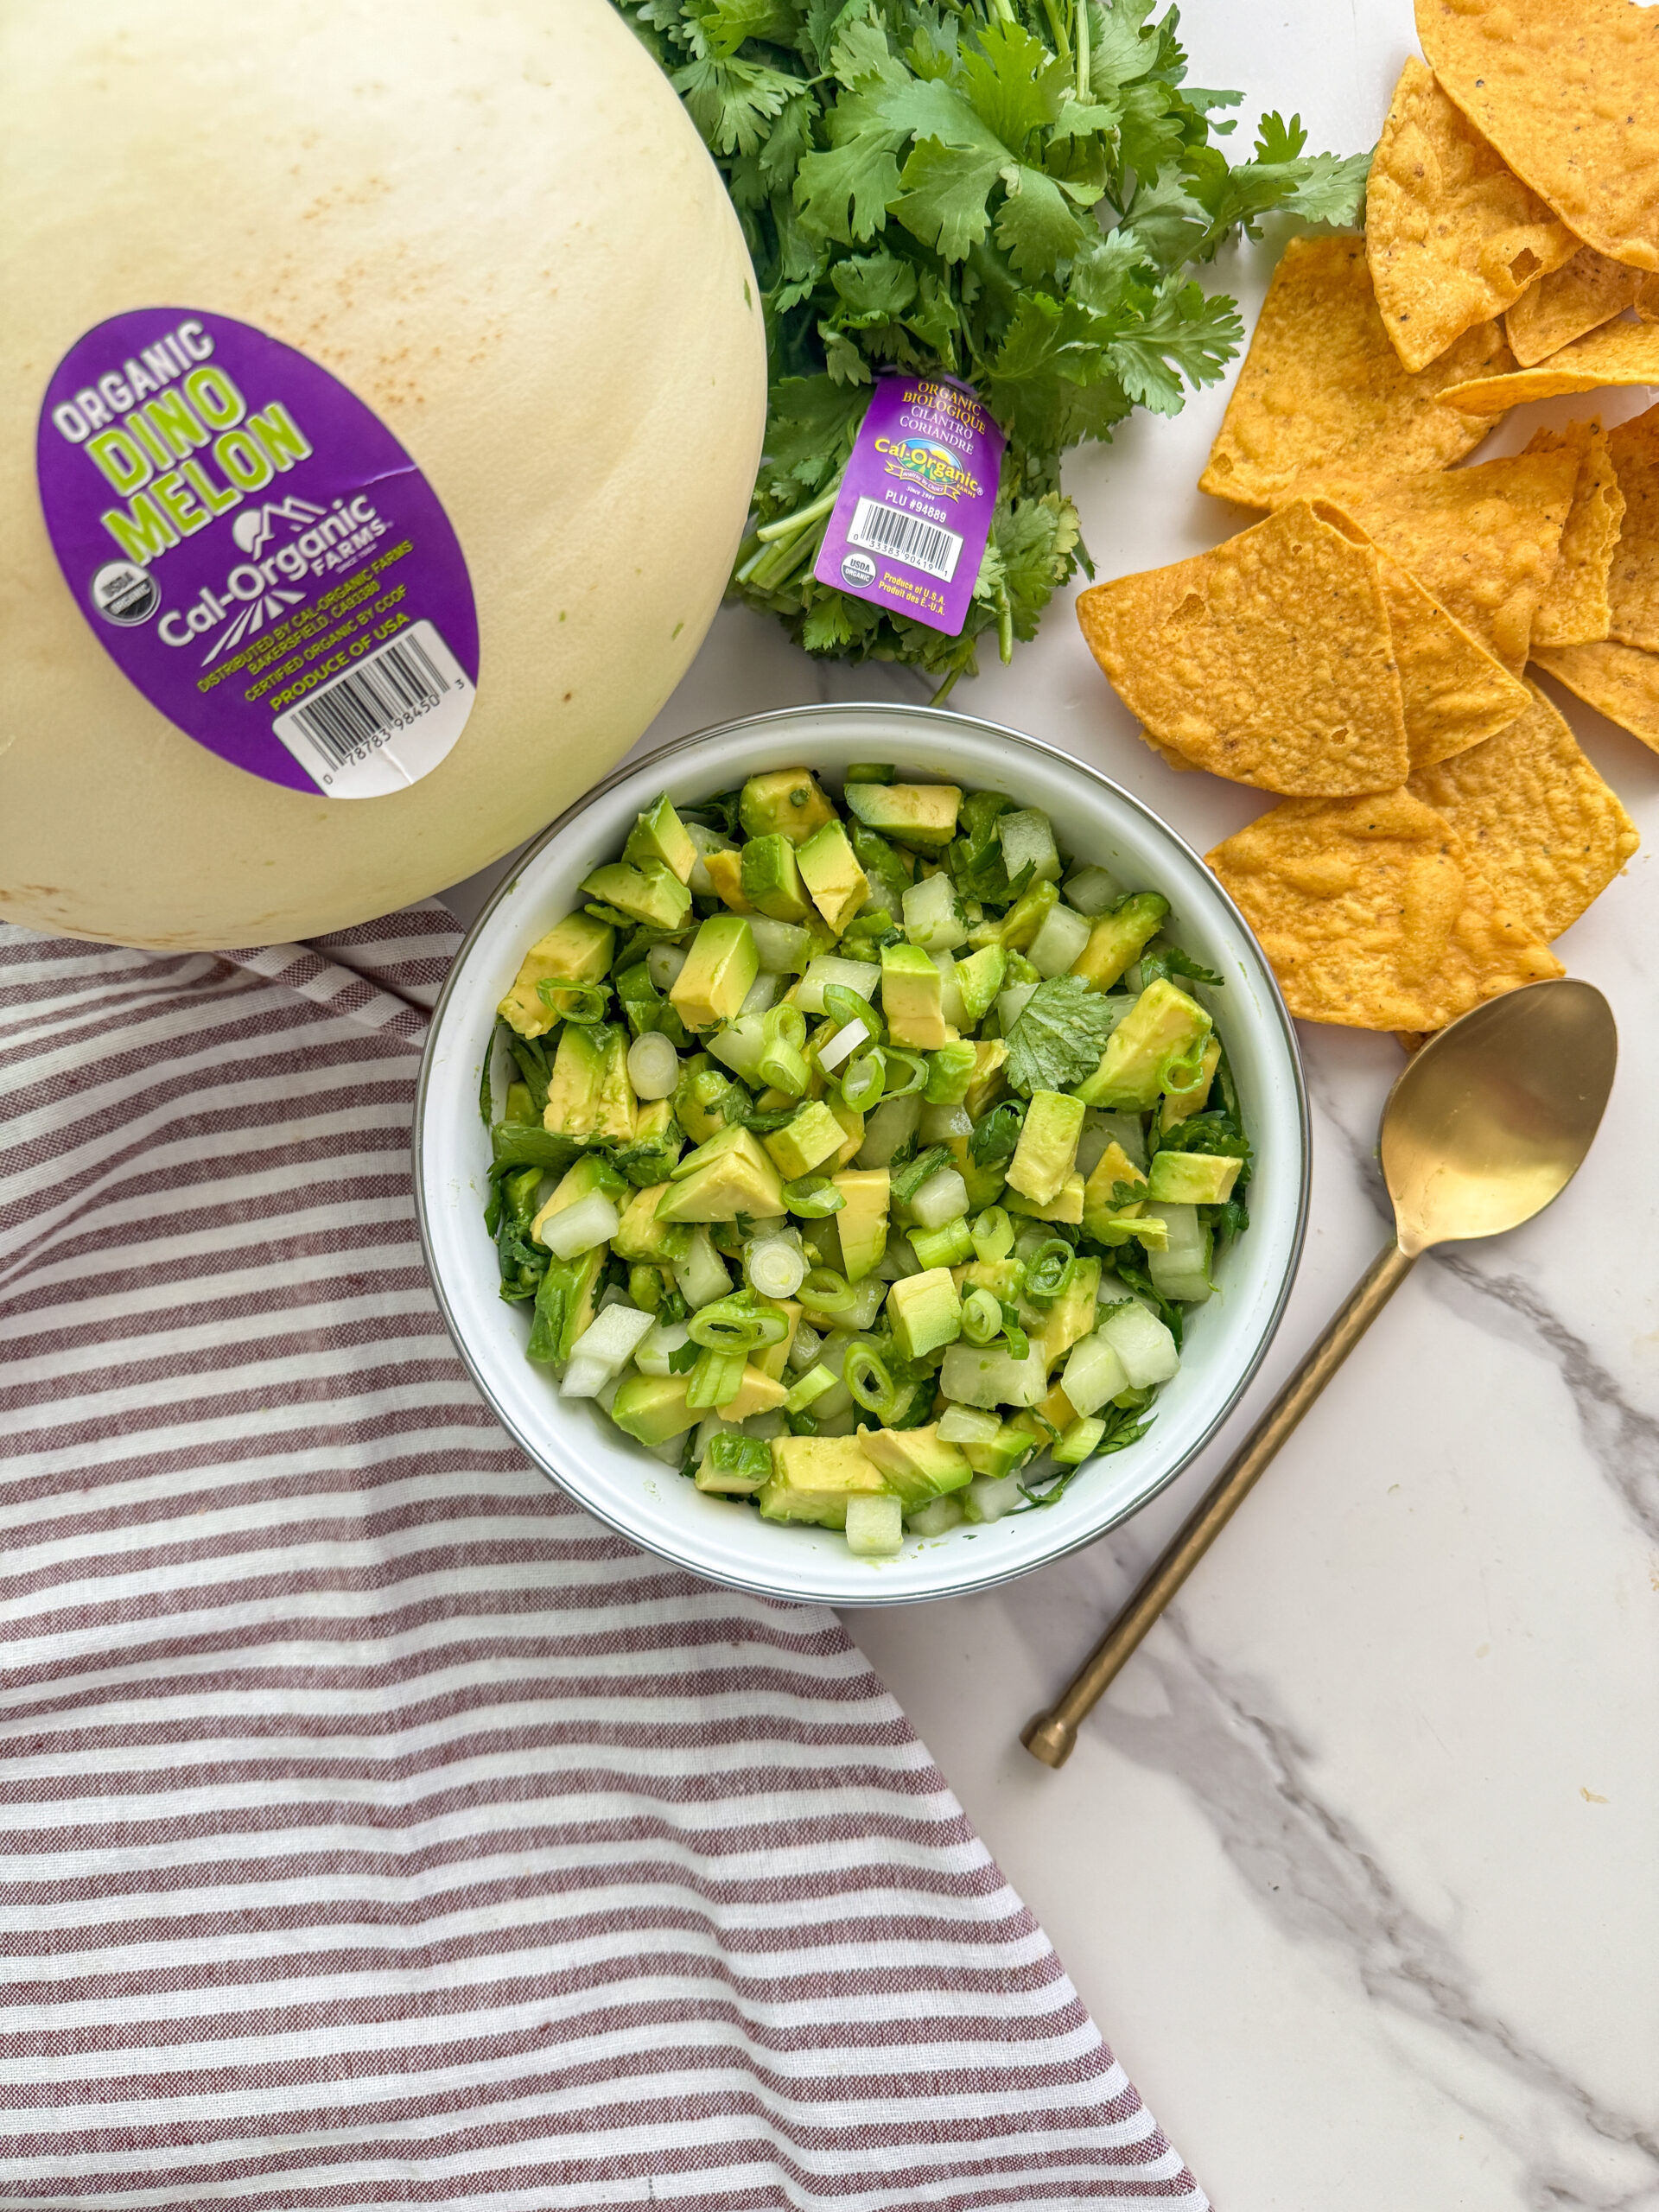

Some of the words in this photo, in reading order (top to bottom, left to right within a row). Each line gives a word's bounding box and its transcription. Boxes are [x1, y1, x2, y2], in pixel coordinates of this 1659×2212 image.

[52, 319, 215, 443] ORGANIC
[918, 382, 981, 416] ORGANIC
[86, 367, 247, 497] DINO
[902, 391, 986, 435] BIOLOGIQUE
[911, 405, 973, 439] CILANTRO
[899, 416, 974, 454] CORIANDRE
[101, 402, 313, 567] MELON
[885, 490, 907, 506] PLU
[909, 500, 946, 523] #94889
[158, 495, 377, 646] Cal-Organic
[845, 568, 870, 582] ORGANIC
[849, 558, 870, 572] USDA
[869, 541, 899, 557] 33383
[905, 553, 933, 570] 90419
[878, 581, 906, 598] Produit
[906, 593, 918, 604] des
[883, 571, 913, 591] Produce
[914, 585, 922, 594] of
[923, 588, 945, 606] U.S.A.
[197, 636, 275, 693] DISTRIBUTED
[273, 622, 291, 640] BY
[291, 569, 372, 628] CAL-ORGANIC
[371, 540, 414, 574] FARMS
[245, 656, 304, 702] CERTIFIED
[303, 620, 358, 661] ORGANIC
[356, 607, 375, 626] BY
[374, 584, 407, 613] CCOF
[270, 652, 350, 711] PRODUCE
[349, 634, 372, 657] OF
[372, 612, 410, 640] USA
[322, 774, 333, 785] 0
[346, 728, 391, 766] 78783
[394, 694, 441, 731] 98450
[454, 678, 465, 690] 3
